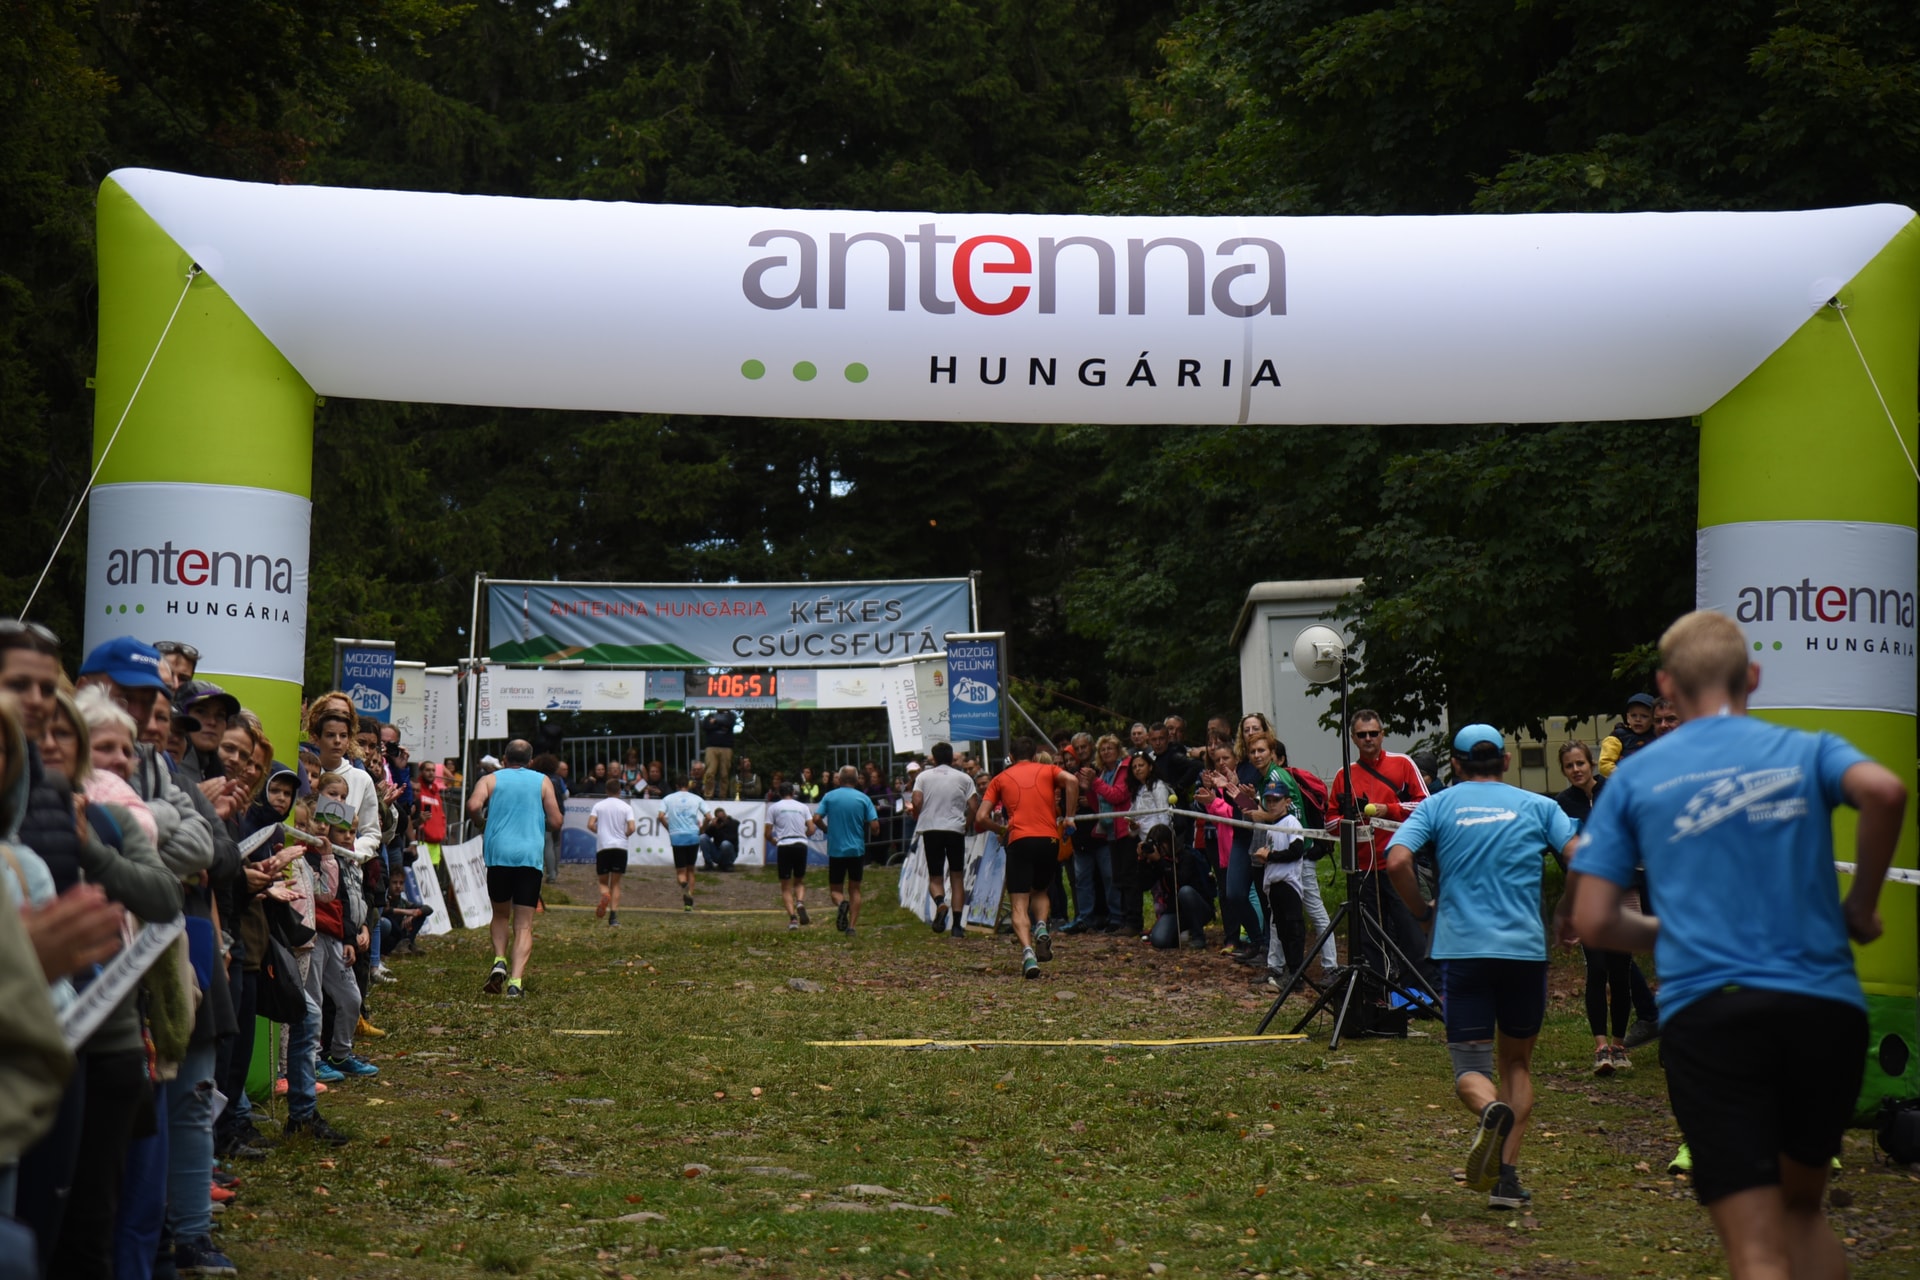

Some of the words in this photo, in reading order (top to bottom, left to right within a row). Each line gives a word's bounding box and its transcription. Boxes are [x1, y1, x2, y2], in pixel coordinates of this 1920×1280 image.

[741, 222, 1287, 319] antenna
[929, 351, 1282, 387] HUNGÁRIA
[106, 541, 293, 595] antenna
[166, 601, 290, 624] HUNGÁRIA
[549, 600, 649, 617] ANTENNA
[655, 598, 768, 617] HUNGÁRIA
[790, 594, 903, 624] KÉKES
[1736, 577, 1915, 629] antenna
[346, 653, 392, 665] MOZOGJ
[949, 647, 994, 658] MOZOGJ
[1806, 637, 1914, 658] HUNGÁRIA
[707, 674, 776, 697] 1:06:51
[969, 686, 988, 701] BSI
[362, 694, 382, 709] BSI
[903, 679, 921, 737] antenna
